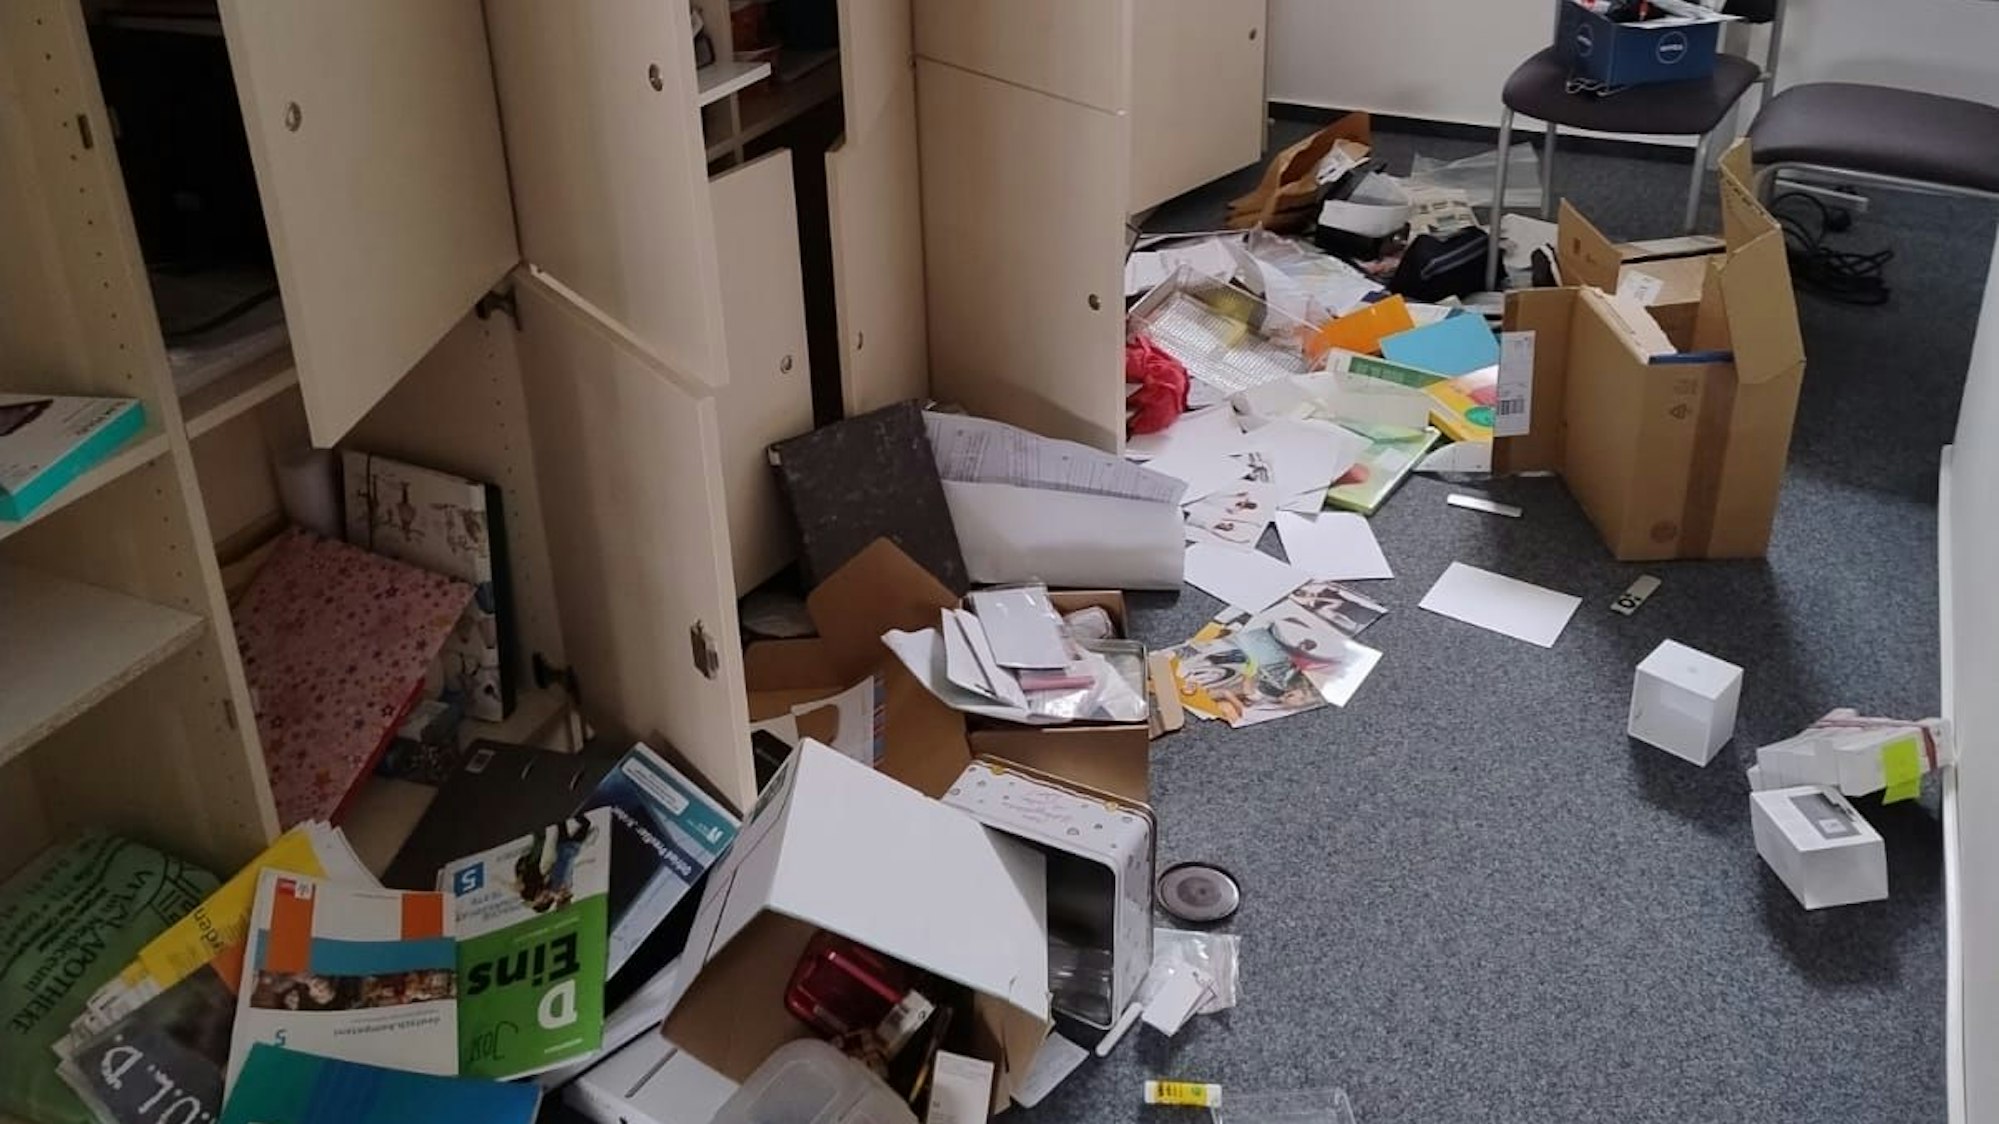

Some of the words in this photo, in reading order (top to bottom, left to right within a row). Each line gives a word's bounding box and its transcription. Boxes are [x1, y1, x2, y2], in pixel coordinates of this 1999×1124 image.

[105, 870, 155, 929] VITAL
[462, 869, 477, 888] 5
[11, 926, 106, 1036] APOTHEKE
[467, 932, 581, 995] Eins
[537, 979, 578, 1030] D
[274, 1029, 288, 1047] 5
